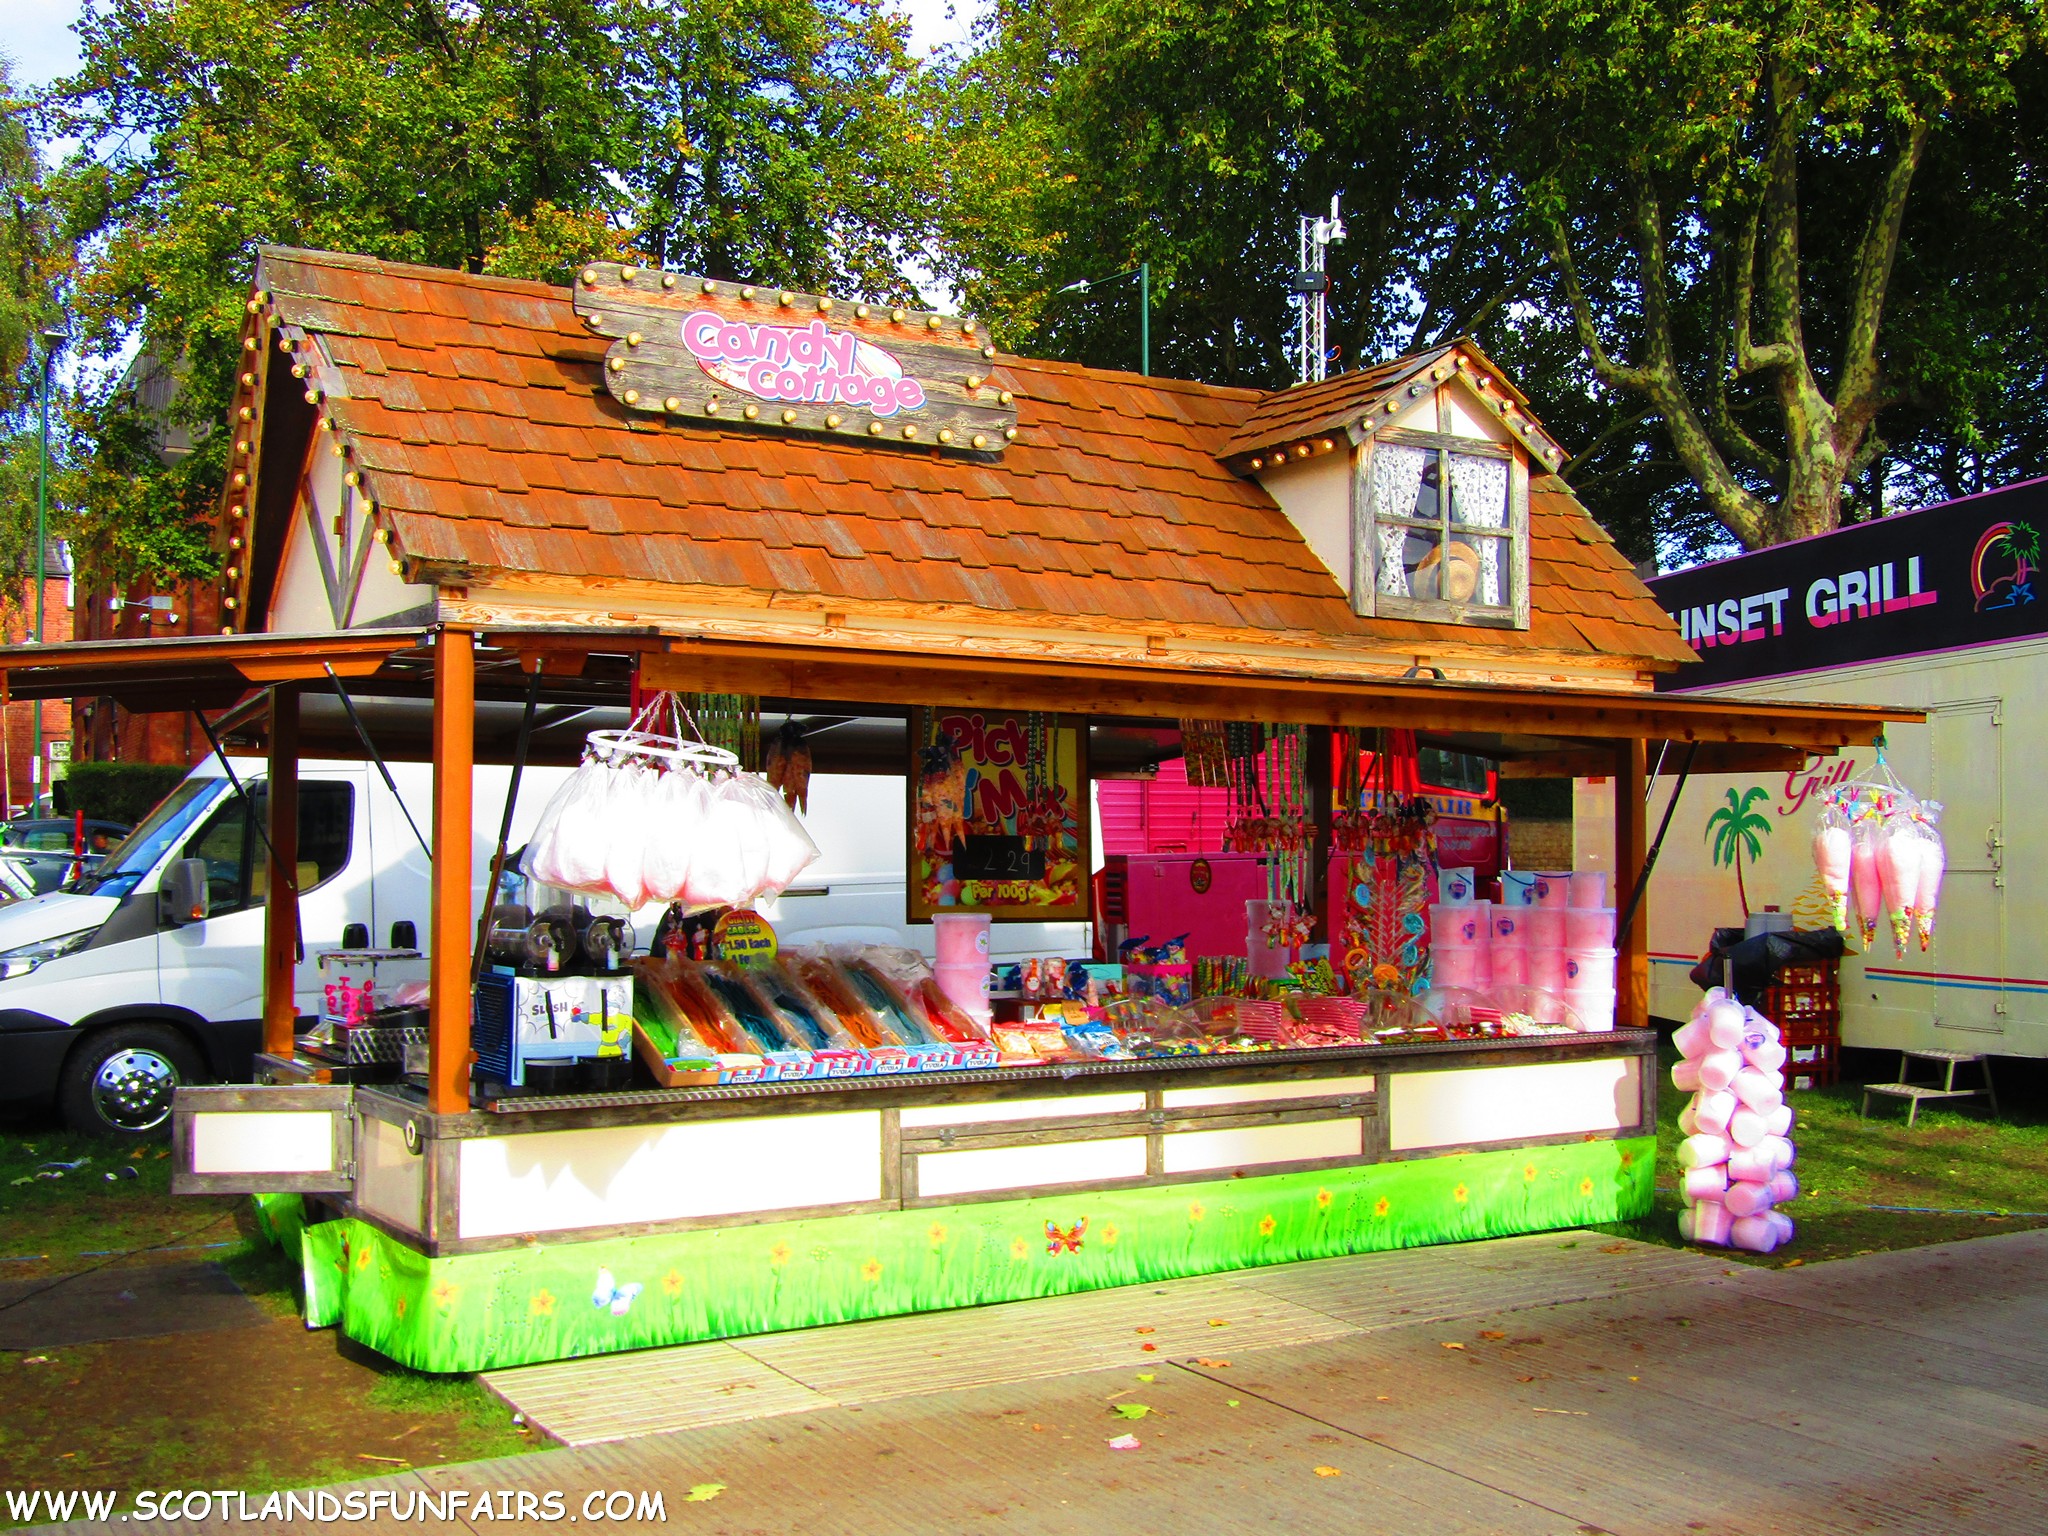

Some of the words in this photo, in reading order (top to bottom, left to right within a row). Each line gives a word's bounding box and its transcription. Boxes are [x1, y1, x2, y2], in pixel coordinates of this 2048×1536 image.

[682, 310, 857, 377] Candy
[747, 360, 926, 416] Cottage
[1805, 556, 1937, 629] GRILL
[531, 1002, 568, 1016] SLSH
